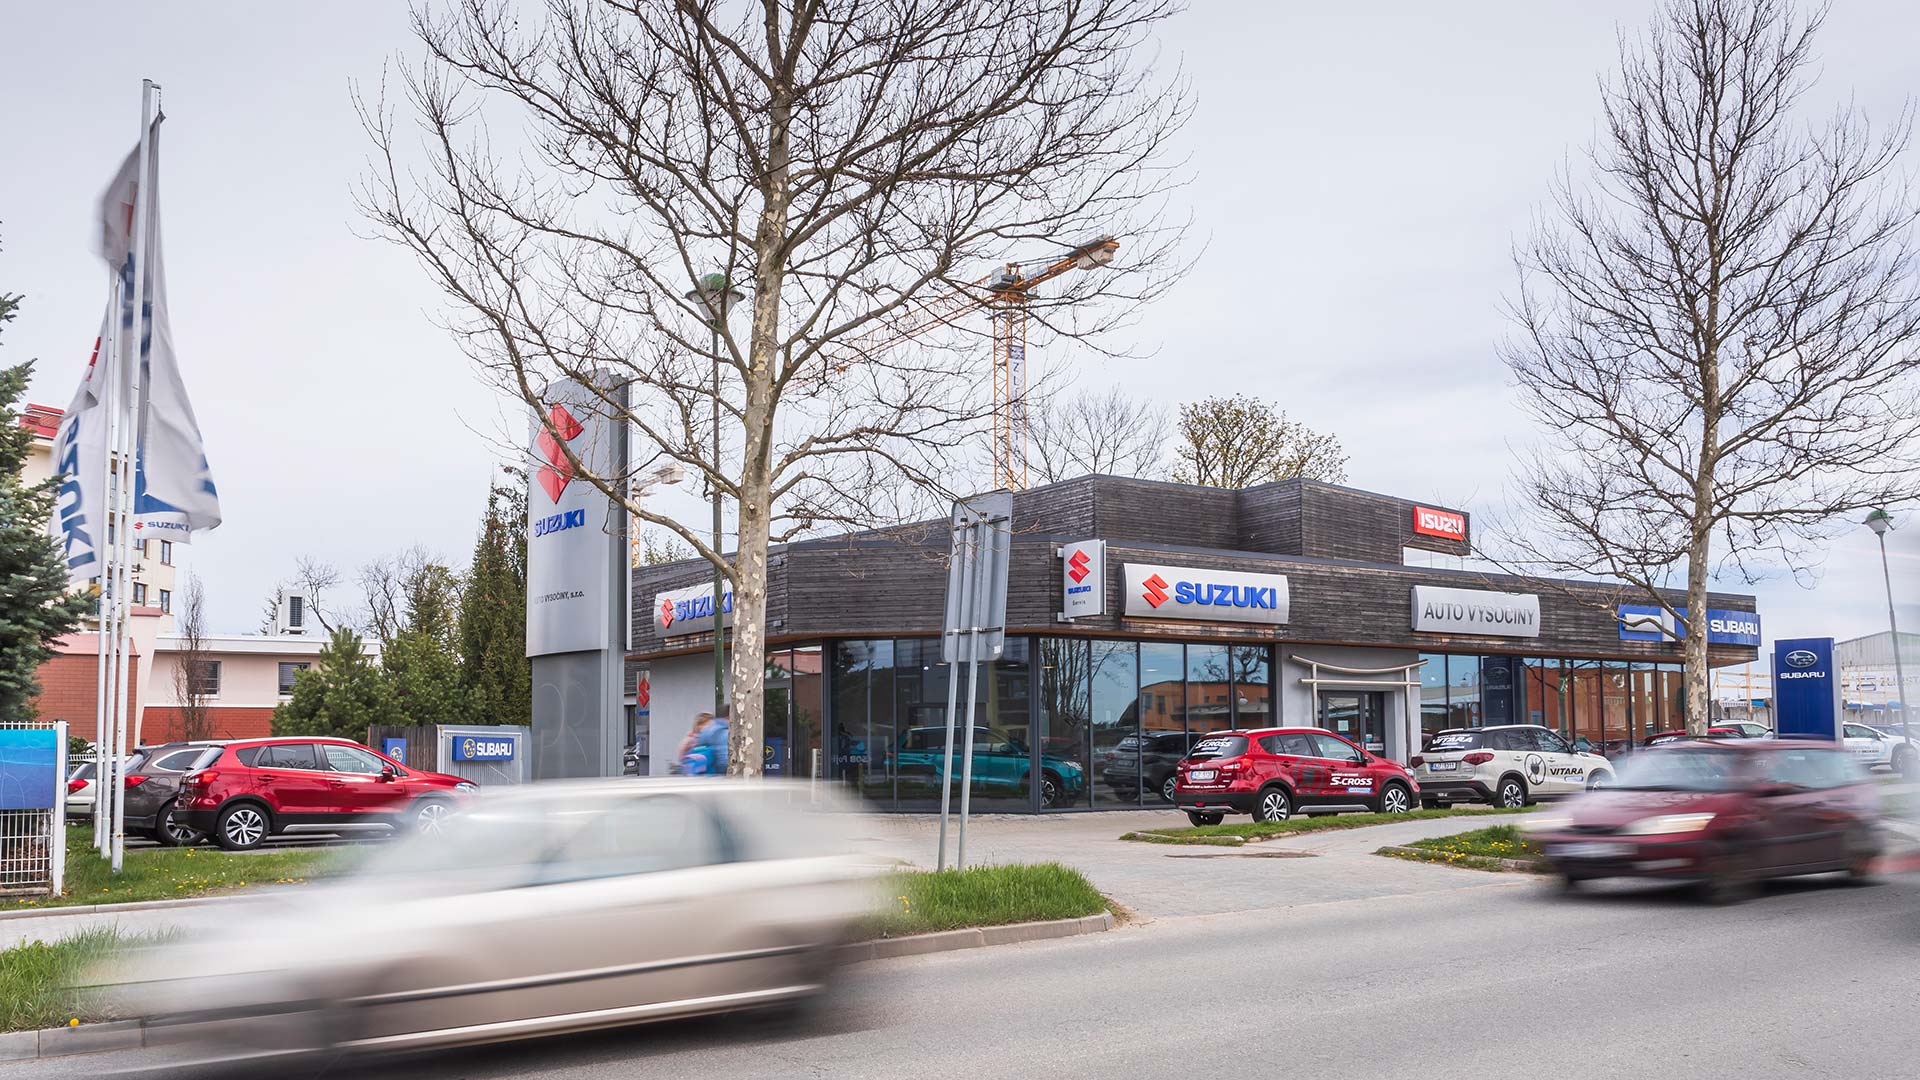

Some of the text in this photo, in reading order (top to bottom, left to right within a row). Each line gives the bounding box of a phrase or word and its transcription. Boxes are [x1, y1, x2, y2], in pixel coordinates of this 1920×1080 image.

[147, 521, 189, 531] SUZUKI
[534, 508, 585, 537] SUZUKI
[1420, 511, 1463, 534] ISUZU
[1175, 581, 1277, 609] SUZUKI
[1424, 602, 1463, 621] AUTO
[1710, 619, 1758, 636] SUBARU
[476, 742, 512, 757] SUBARU
[1550, 767, 1584, 775] VITARA
[1330, 776, 1373, 786] S-CROSS
